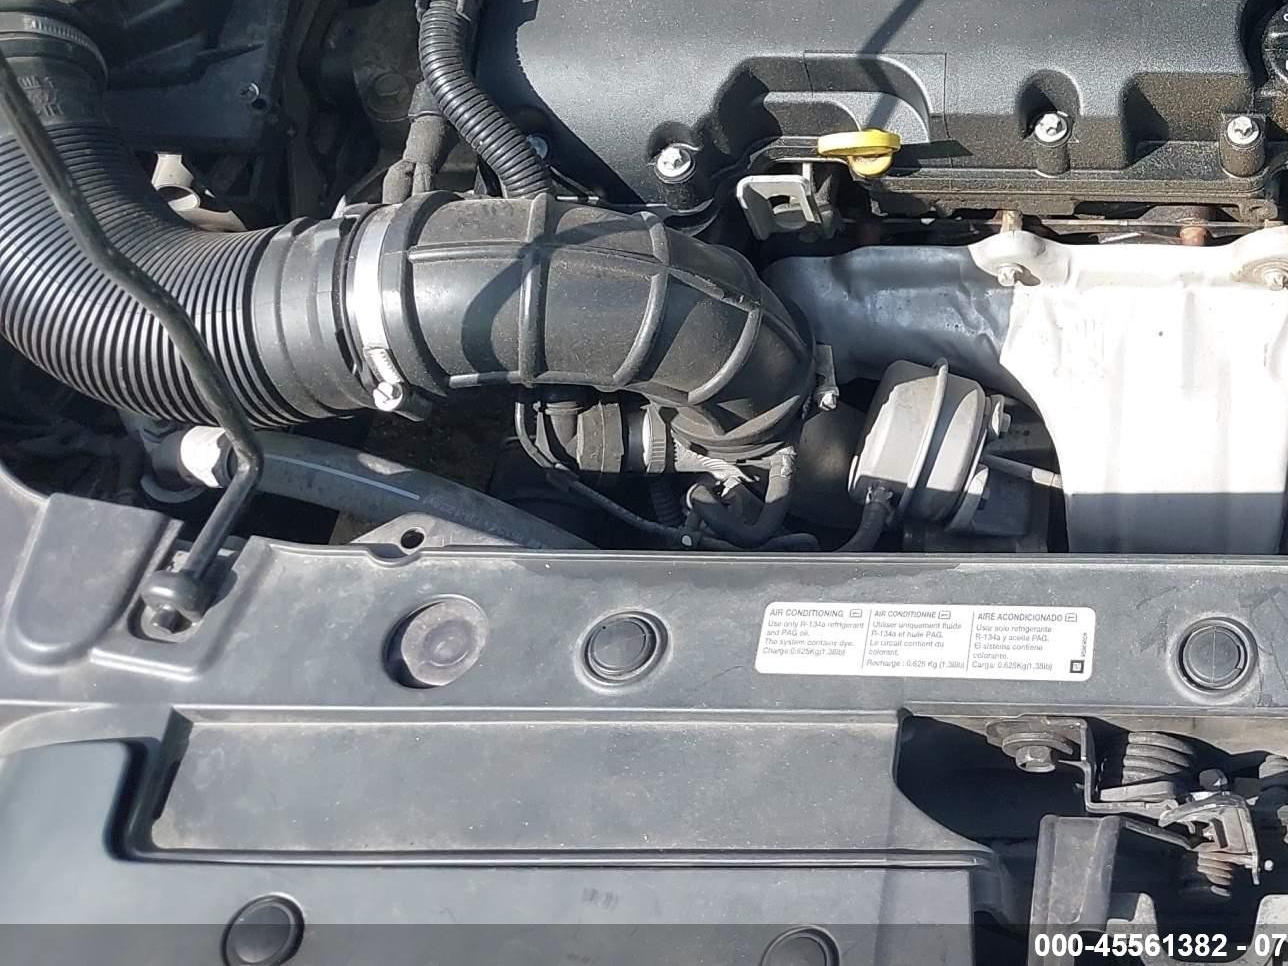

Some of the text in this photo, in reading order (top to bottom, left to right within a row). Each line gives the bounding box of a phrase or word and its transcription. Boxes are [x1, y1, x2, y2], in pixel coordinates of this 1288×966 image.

[786, 609, 844, 617] CONDITIONING
[997, 613, 1063, 621] ACONDICIONADO
[784, 620, 798, 628] only
[828, 621, 864, 629] refrigerant
[873, 621, 896, 629] Utiliser
[898, 622, 940, 630] uniquement
[1011, 625, 1052, 633] refrigerante
[975, 633, 1000, 641] R-134a
[866, 659, 900, 668] Recharge
[927, 661, 937, 669] Kg
